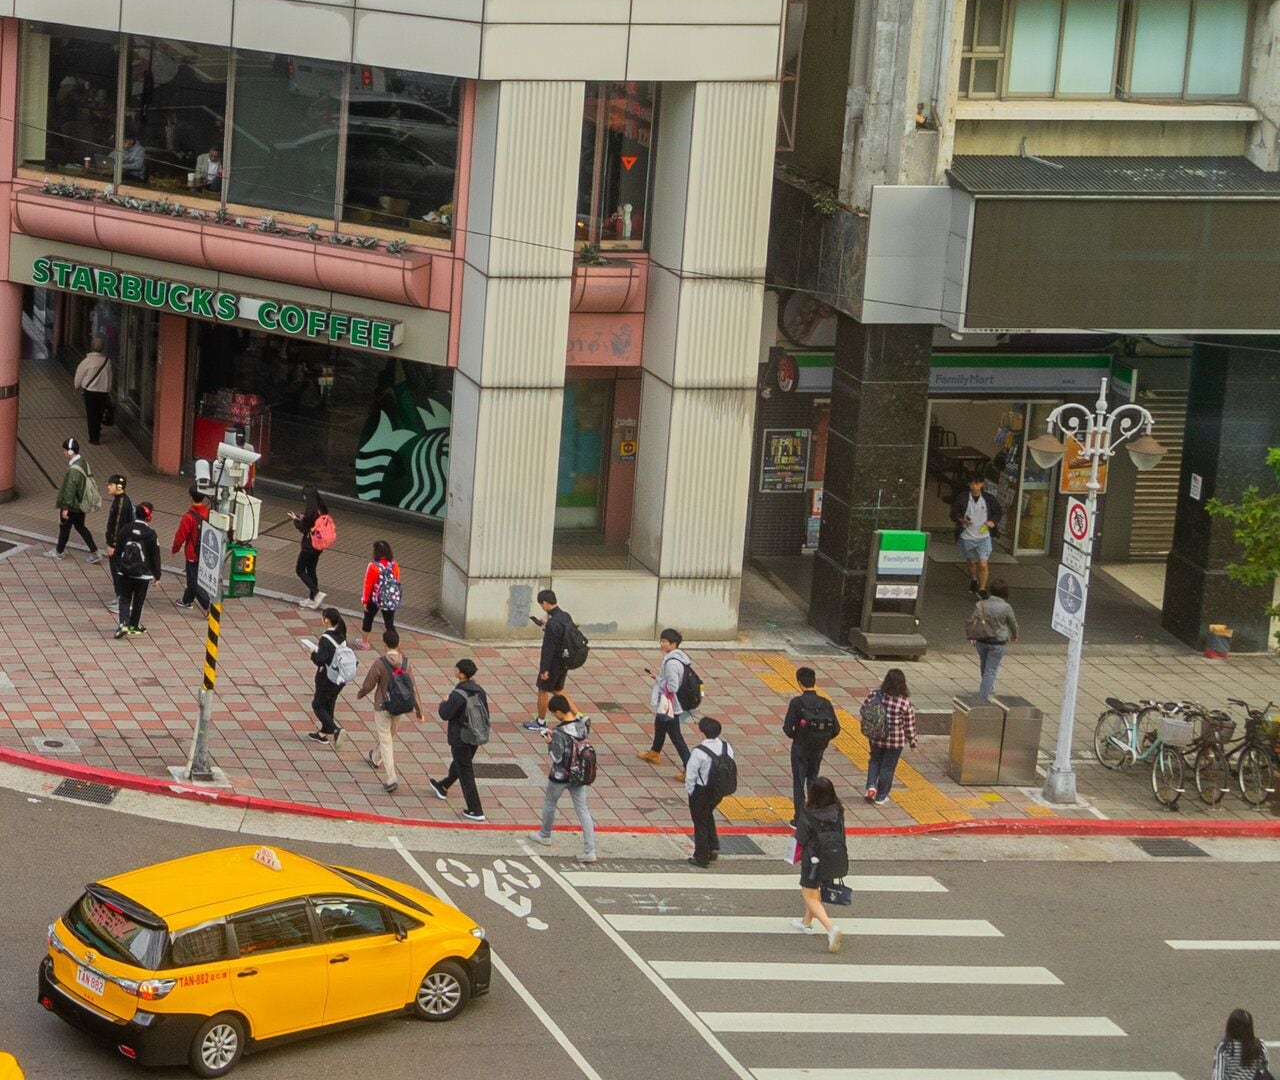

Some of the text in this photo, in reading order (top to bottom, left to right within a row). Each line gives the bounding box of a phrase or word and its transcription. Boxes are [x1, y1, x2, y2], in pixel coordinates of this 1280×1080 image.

[31, 257, 392, 352] STARBUCKS COFFEE
[935, 374, 994, 385] FamilyMart
[882, 554, 921, 566] FamilyMart
